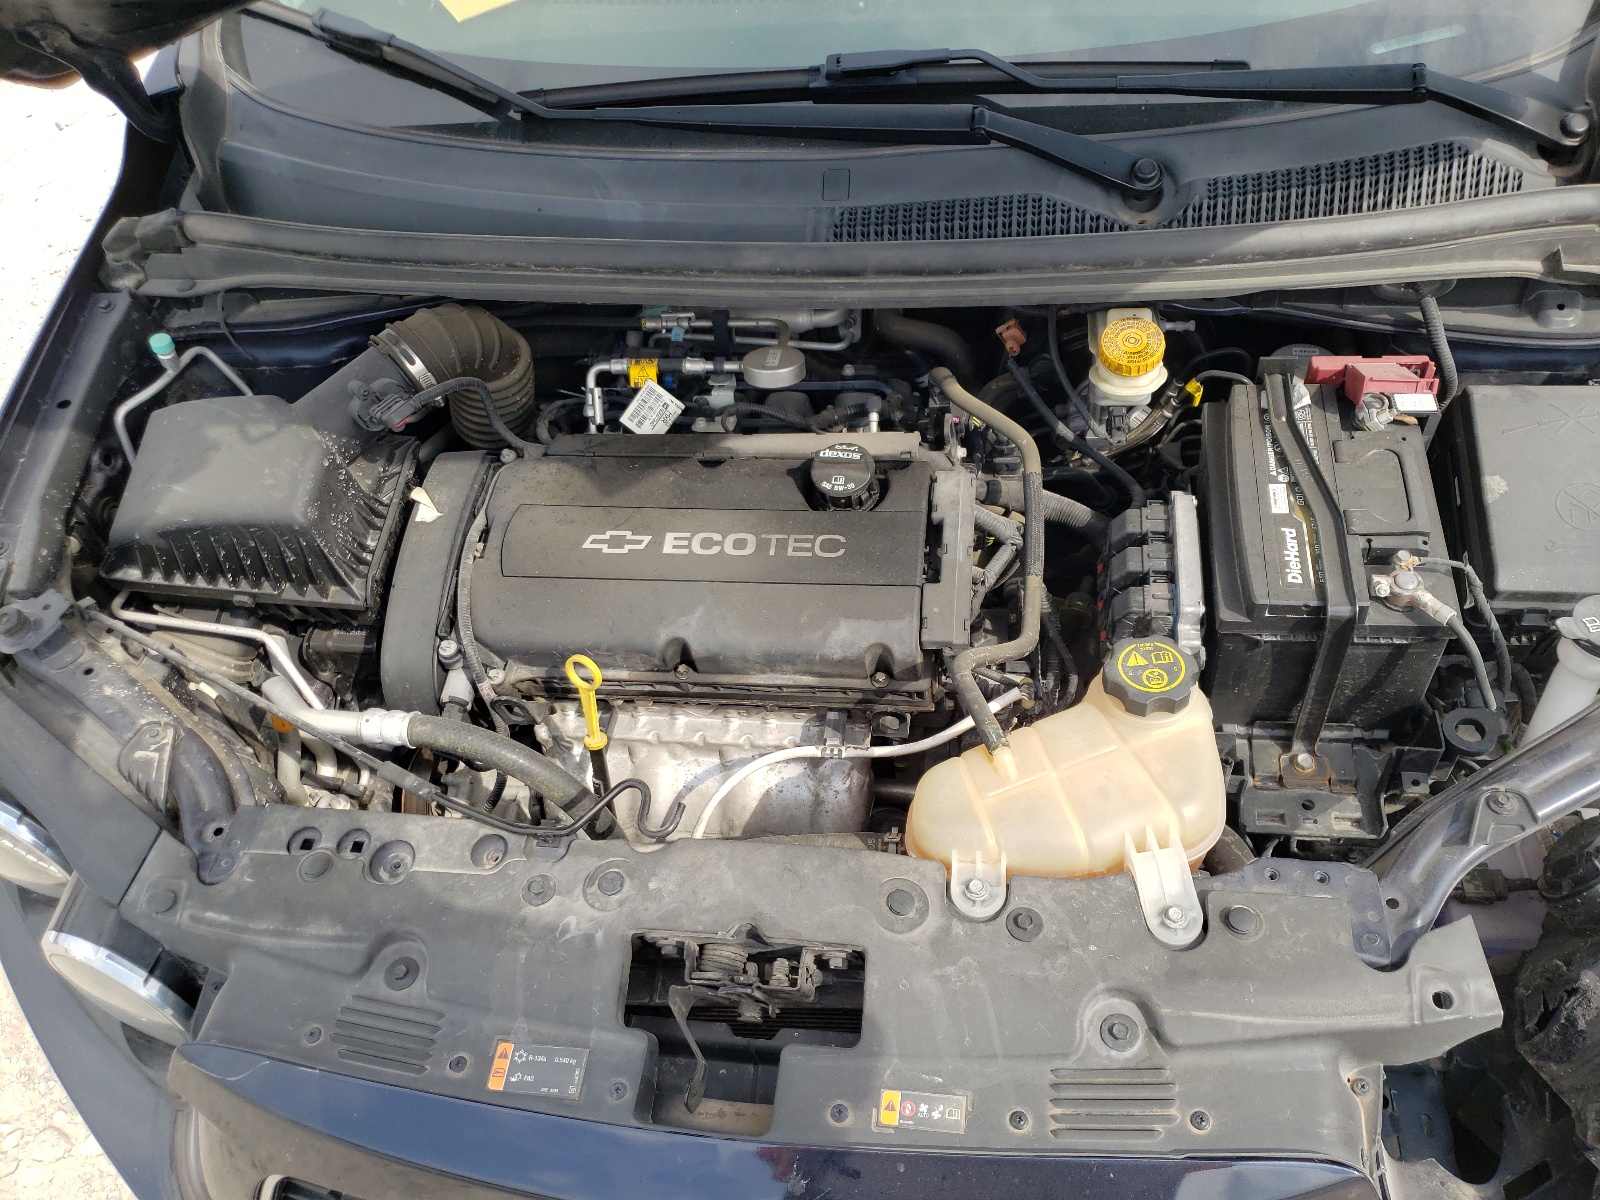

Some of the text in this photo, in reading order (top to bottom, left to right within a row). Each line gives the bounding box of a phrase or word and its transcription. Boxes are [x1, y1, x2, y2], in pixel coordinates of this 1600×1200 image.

[819, 449, 863, 460] dexos
[821, 481, 855, 491] SAE 5W-30
[662, 532, 847, 557] ECOTEC
[1281, 526, 1303, 586] DieHard
